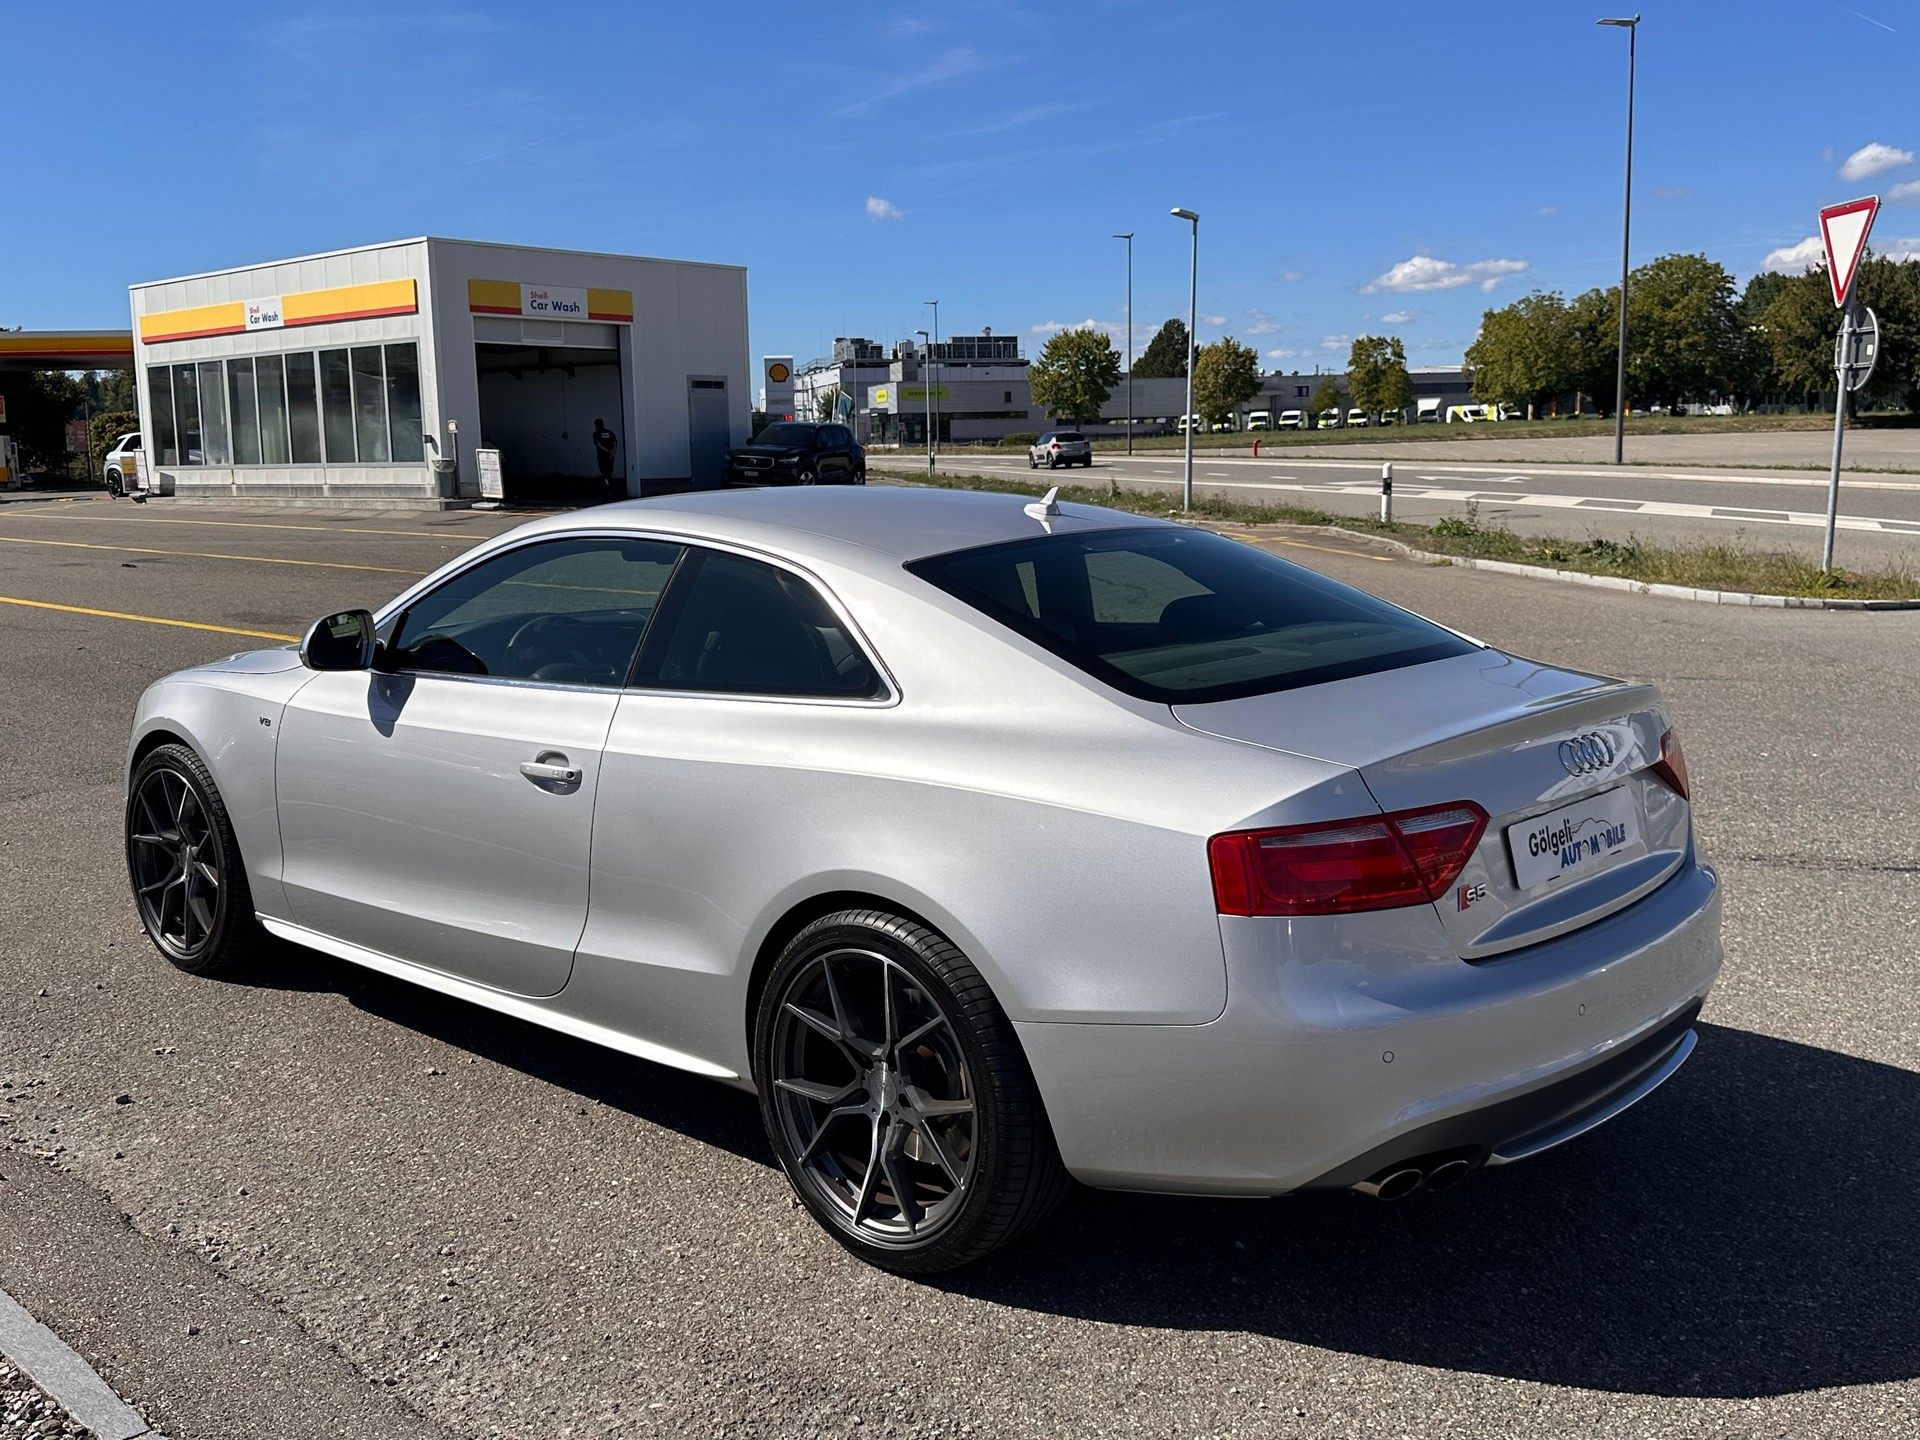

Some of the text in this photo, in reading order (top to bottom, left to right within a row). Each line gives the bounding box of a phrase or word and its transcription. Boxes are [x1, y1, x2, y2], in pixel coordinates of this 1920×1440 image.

[530, 291, 548, 300] Shell
[249, 306, 260, 314] Shell
[530, 300, 580, 312] Car Wash
[250, 311, 279, 324] Car Wash
[1528, 818, 1573, 857] Gölgeli
[1561, 823, 1626, 868] AUTOMOBILE
